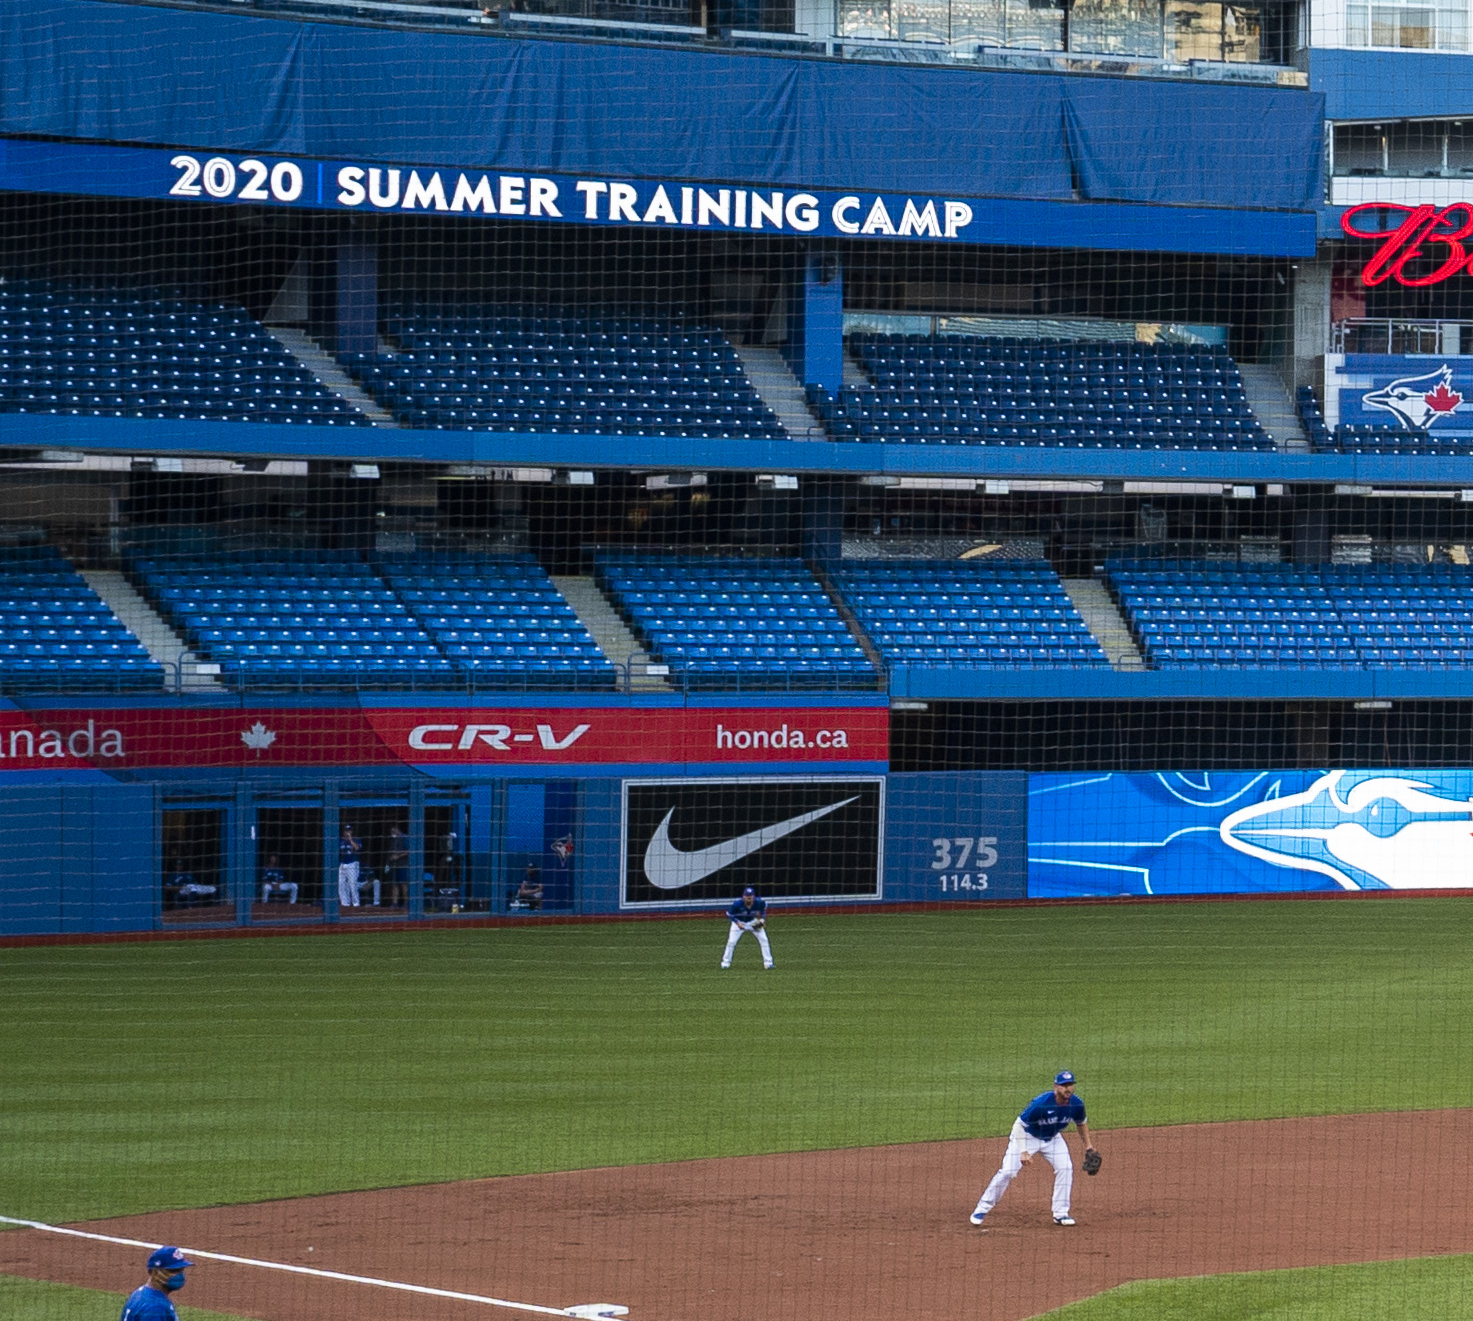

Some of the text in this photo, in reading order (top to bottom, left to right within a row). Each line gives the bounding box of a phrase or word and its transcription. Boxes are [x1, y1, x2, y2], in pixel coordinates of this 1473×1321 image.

[169, 154, 973, 239] 2020 SUMMER TRAINING CAMP
[0, 719, 126, 758] nada
[407, 723, 591, 751] CR-V
[715, 723, 849, 751] honda.ca
[931, 836, 999, 870] 375
[939, 872, 988, 893] 114.3
